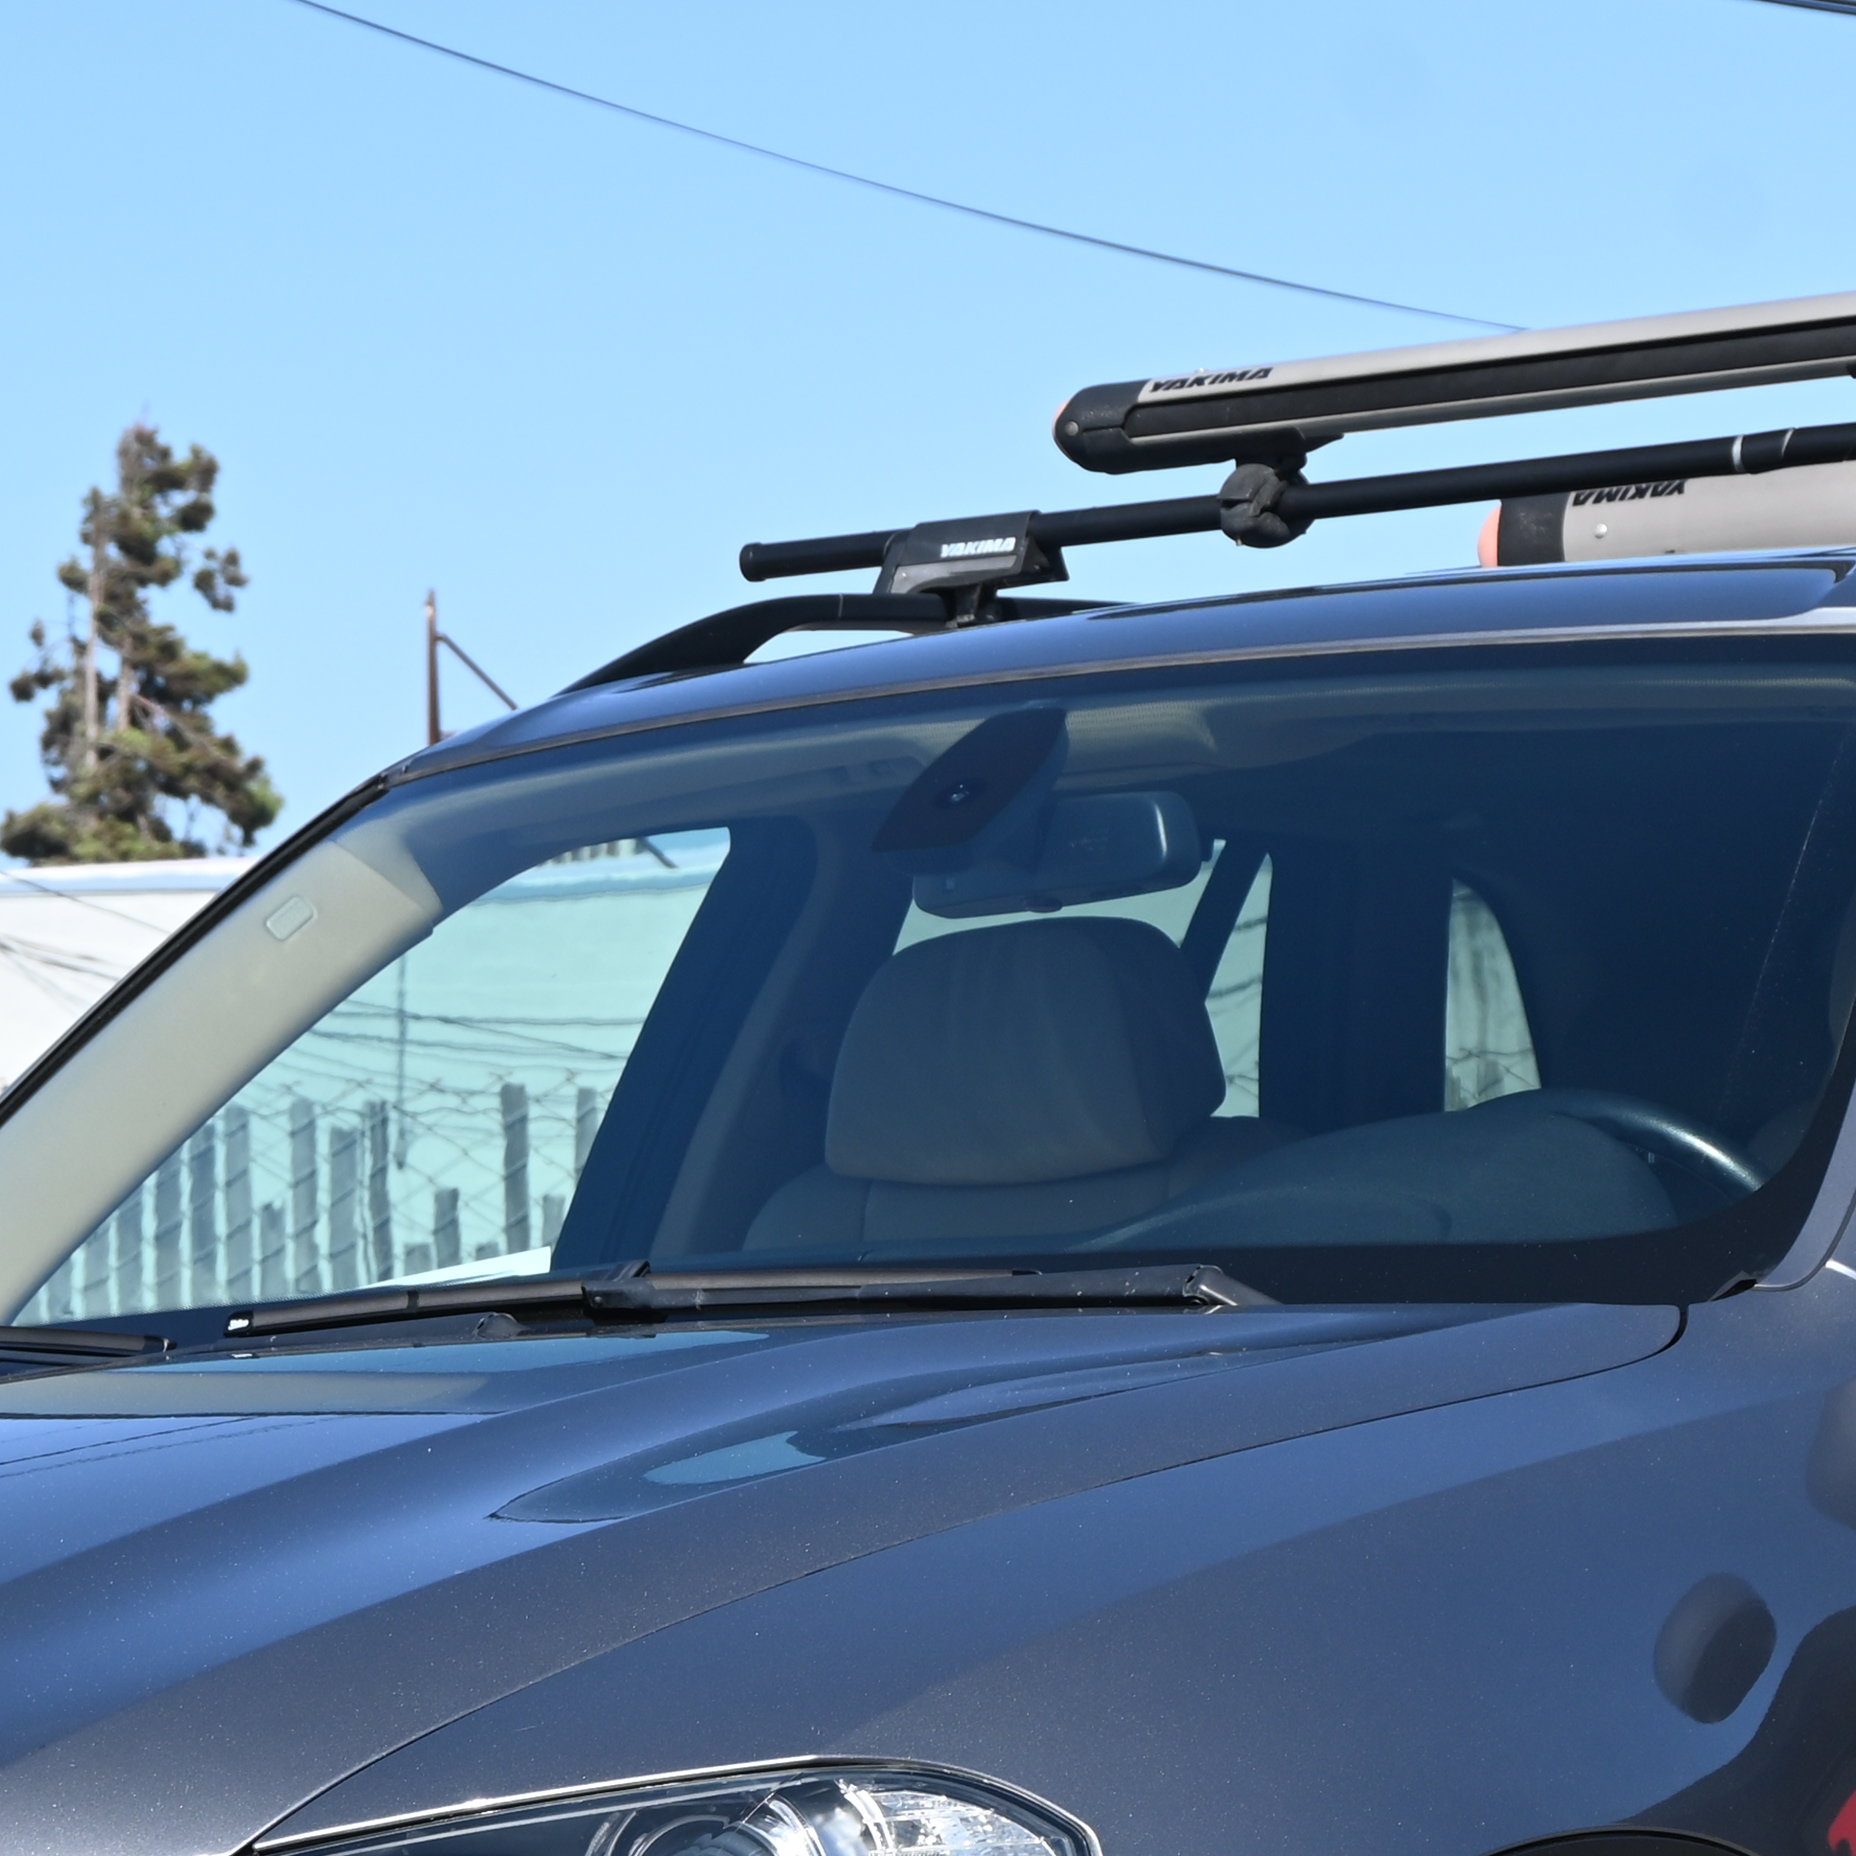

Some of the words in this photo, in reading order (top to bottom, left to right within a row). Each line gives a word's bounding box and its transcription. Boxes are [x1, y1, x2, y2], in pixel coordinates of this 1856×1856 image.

[1149, 366, 1274, 393] YAKIMA
[1571, 479, 1689, 507] YAKIMA
[940, 536, 1016, 558] YAKIMA
